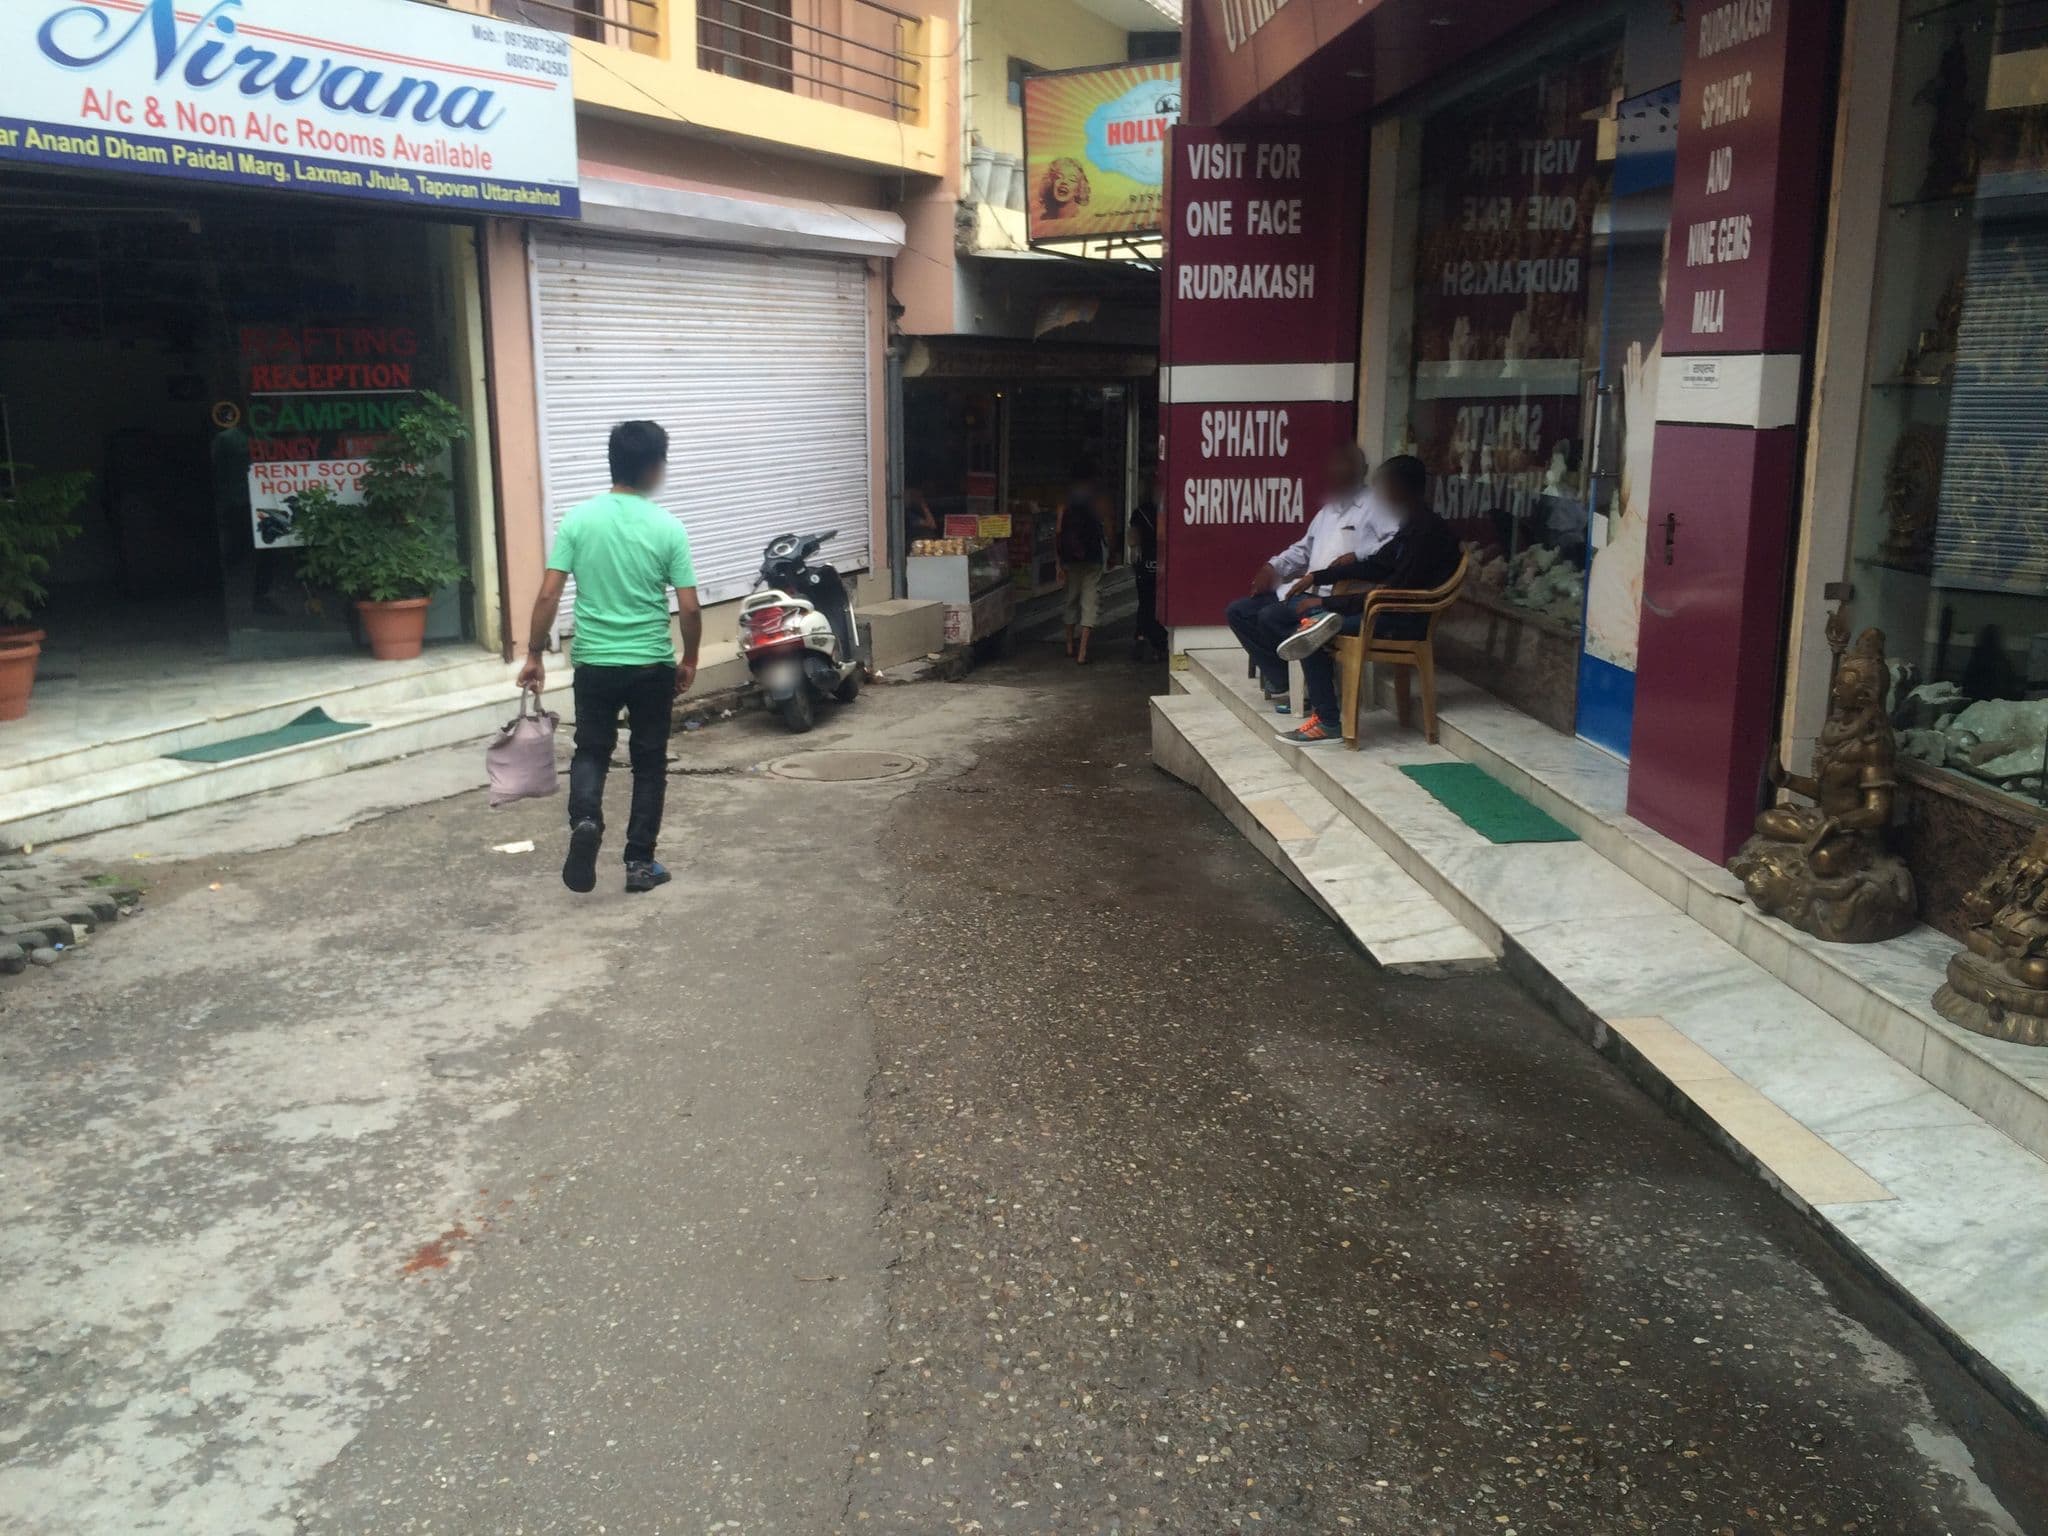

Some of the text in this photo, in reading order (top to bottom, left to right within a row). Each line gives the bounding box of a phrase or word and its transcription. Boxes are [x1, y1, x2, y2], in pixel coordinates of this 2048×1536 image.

[37, 0, 506, 131] Nirvana
[1701, 71, 1753, 130] SPHATIC
[80, 87, 493, 171] A/c & Non A/c Rooms Available
[25, 127, 99, 157] Anand
[104, 136, 168, 165] Dham
[171, 144, 235, 172] Paidal
[238, 152, 290, 182] Marg,
[293, 160, 362, 187] Laxman
[366, 170, 414, 195] Jhula,
[417, 175, 479, 200] Tapovan
[1187, 143, 1300, 180] VISIT FOR
[1706, 146, 1733, 195] AND
[1186, 199, 1302, 237] ONE FACE
[1686, 213, 1752, 268] NINE GEMS
[1178, 264, 1314, 300] RUDRAKASH
[1691, 289, 1725, 334] MALA
[240, 327, 417, 358] RAFTING
[250, 363, 412, 391] RECEPTION
[1201, 410, 1288, 458] SPHATIC
[255, 463, 310, 479] RENT
[1184, 478, 1304, 525] SHRIYANTRA
